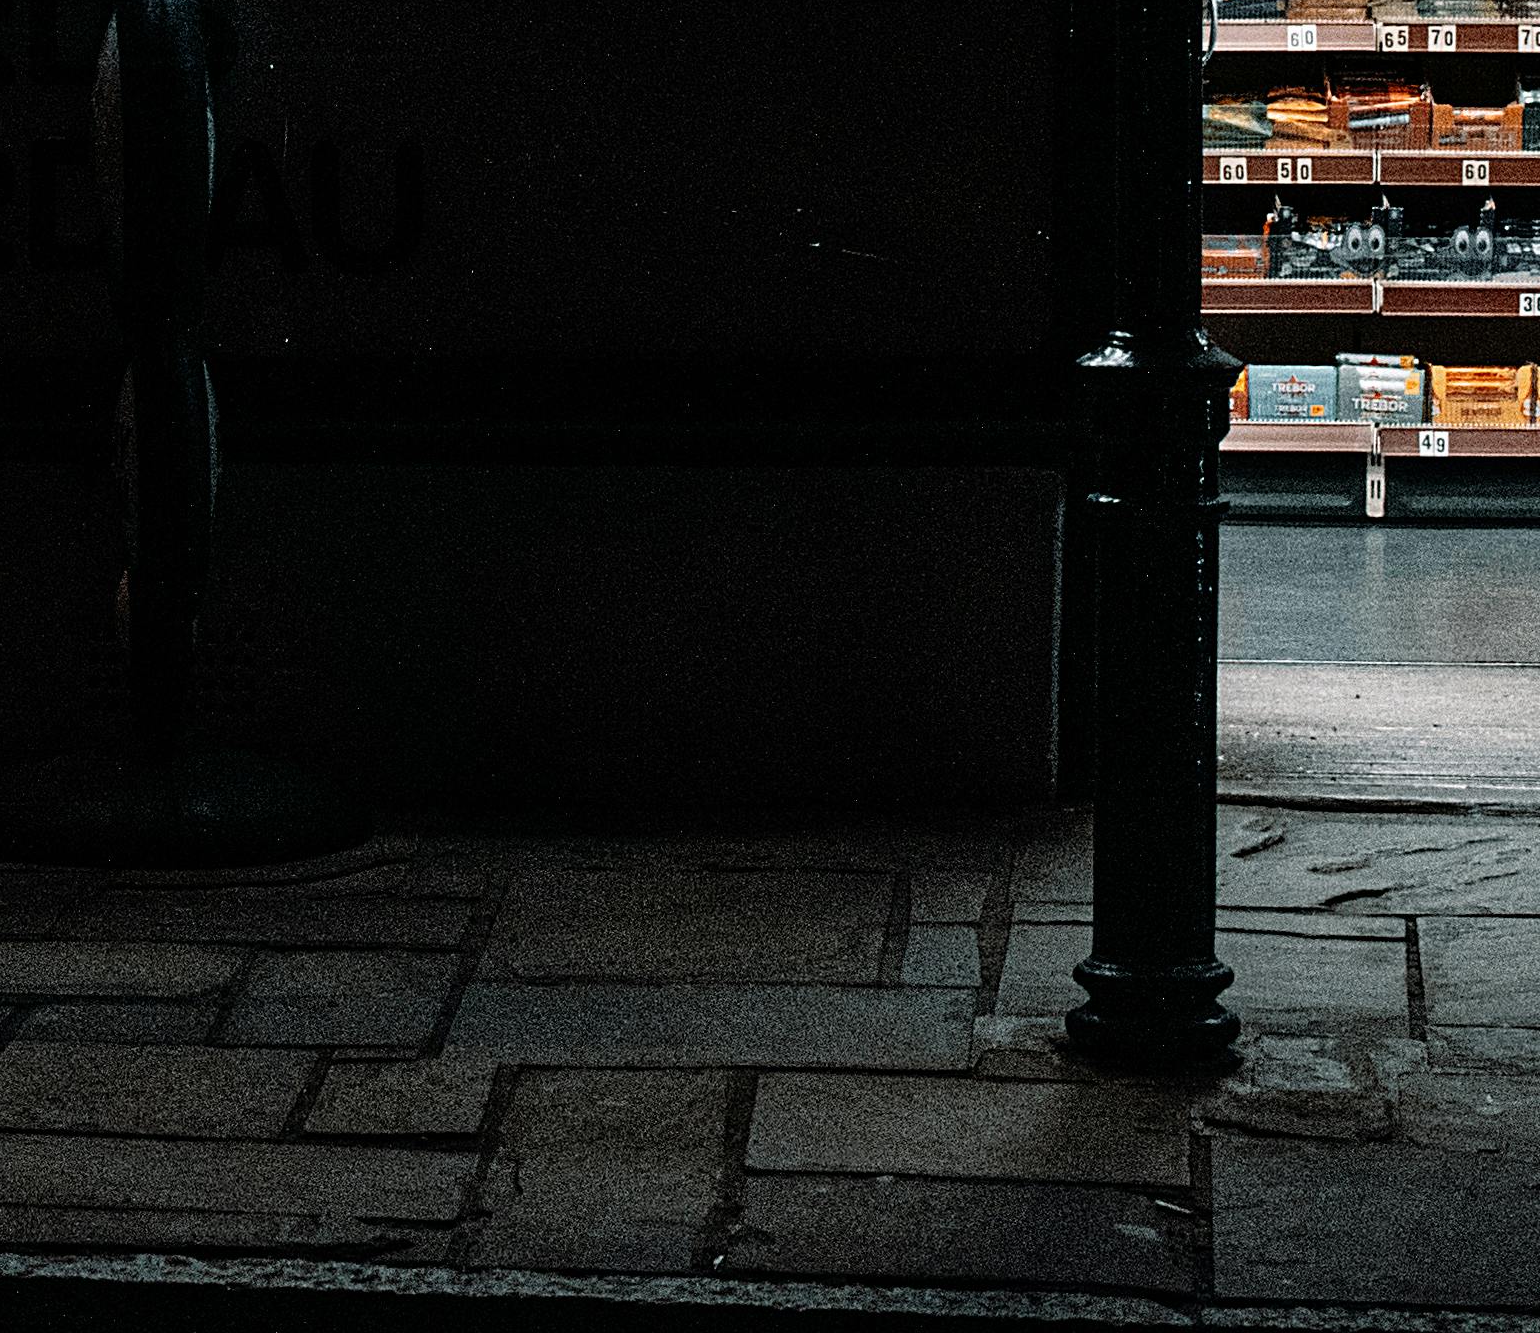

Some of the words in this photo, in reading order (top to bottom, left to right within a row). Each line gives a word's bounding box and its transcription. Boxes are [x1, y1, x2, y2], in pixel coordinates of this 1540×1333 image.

[1290, 30, 1314, 47] 60
[1384, 29, 1407, 48] 65
[1431, 29, 1454, 46] 70
[1222, 163, 1245, 181] 60
[1280, 162, 1310, 180] 50
[1464, 162, 1488, 181] 60
[1270, 382, 1317, 395] TREBOR
[1273, 403, 1309, 416] TREBOR
[1350, 396, 1409, 414] TREBOR
[1420, 434, 1447, 453] 49
